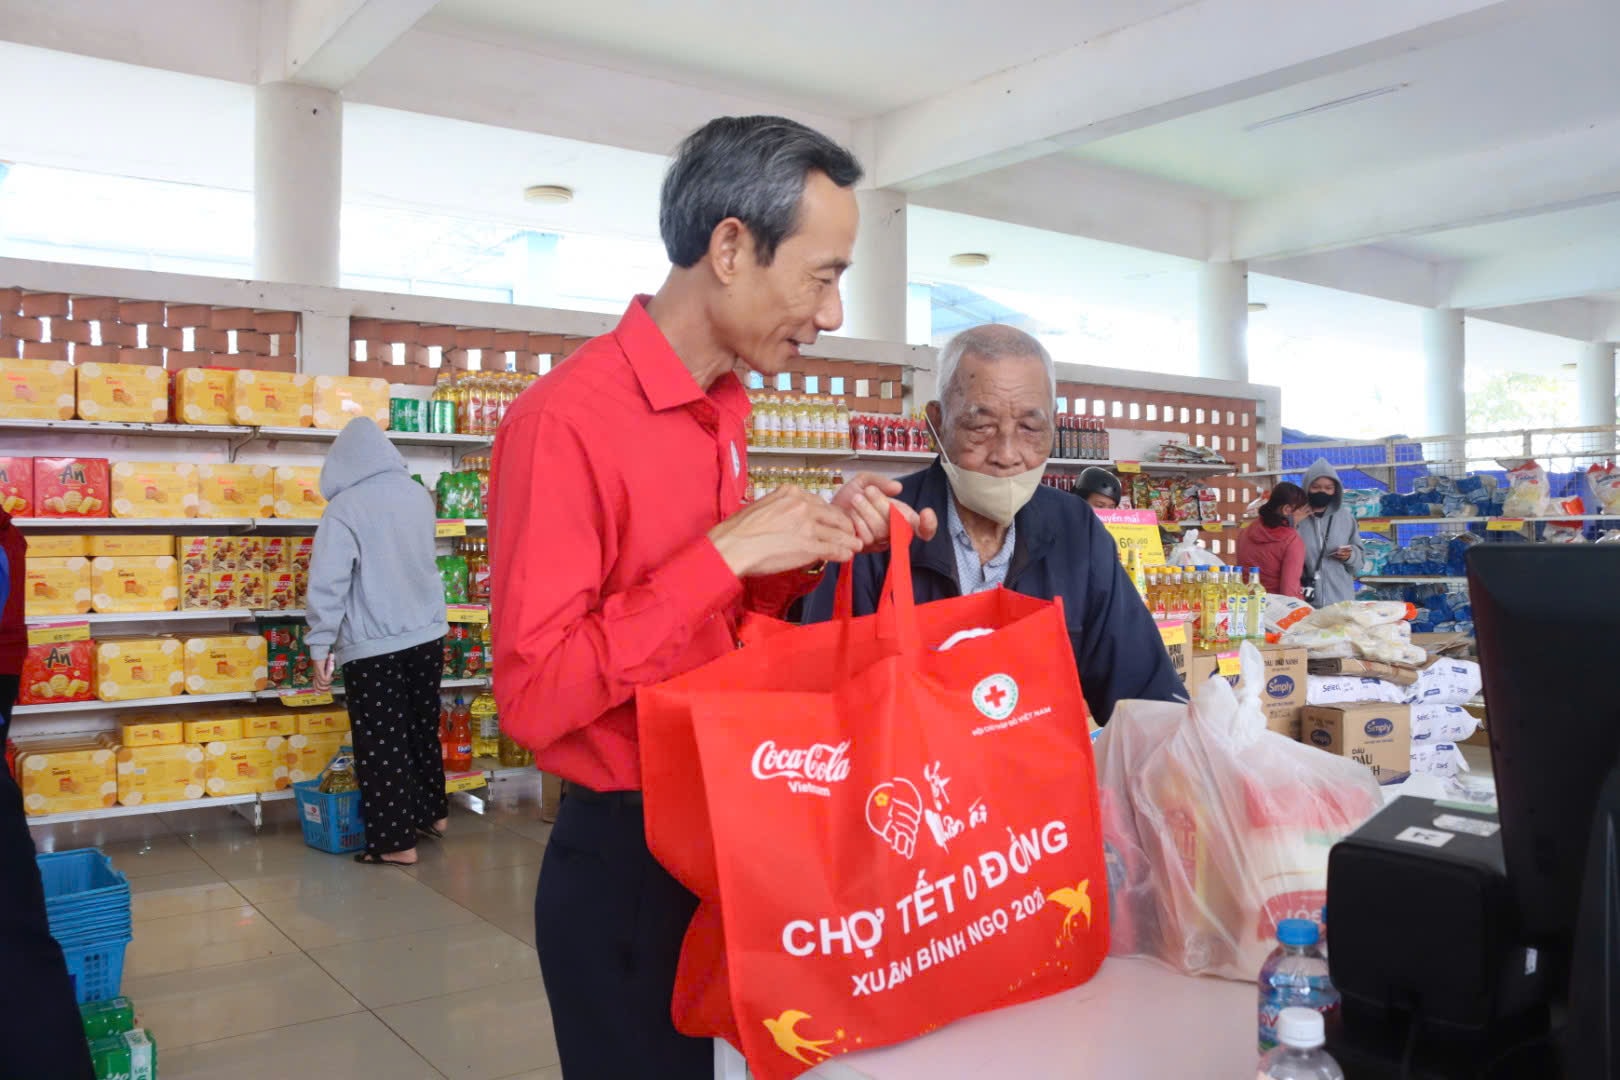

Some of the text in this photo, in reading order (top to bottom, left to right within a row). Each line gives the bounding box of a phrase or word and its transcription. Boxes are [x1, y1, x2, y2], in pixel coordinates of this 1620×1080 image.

[60, 463, 87, 485] An
[43, 647, 72, 669] An
[1268, 678, 1293, 694] Simply
[1366, 721, 1392, 734] Simply
[752, 737, 851, 782] Coca-Cola
[782, 907, 885, 958] CHỢ
[896, 868, 956, 935] TẾT
[852, 957, 913, 997] XUÂN
[916, 931, 967, 971] BÍNH
[966, 908, 1009, 946] NGỌ
